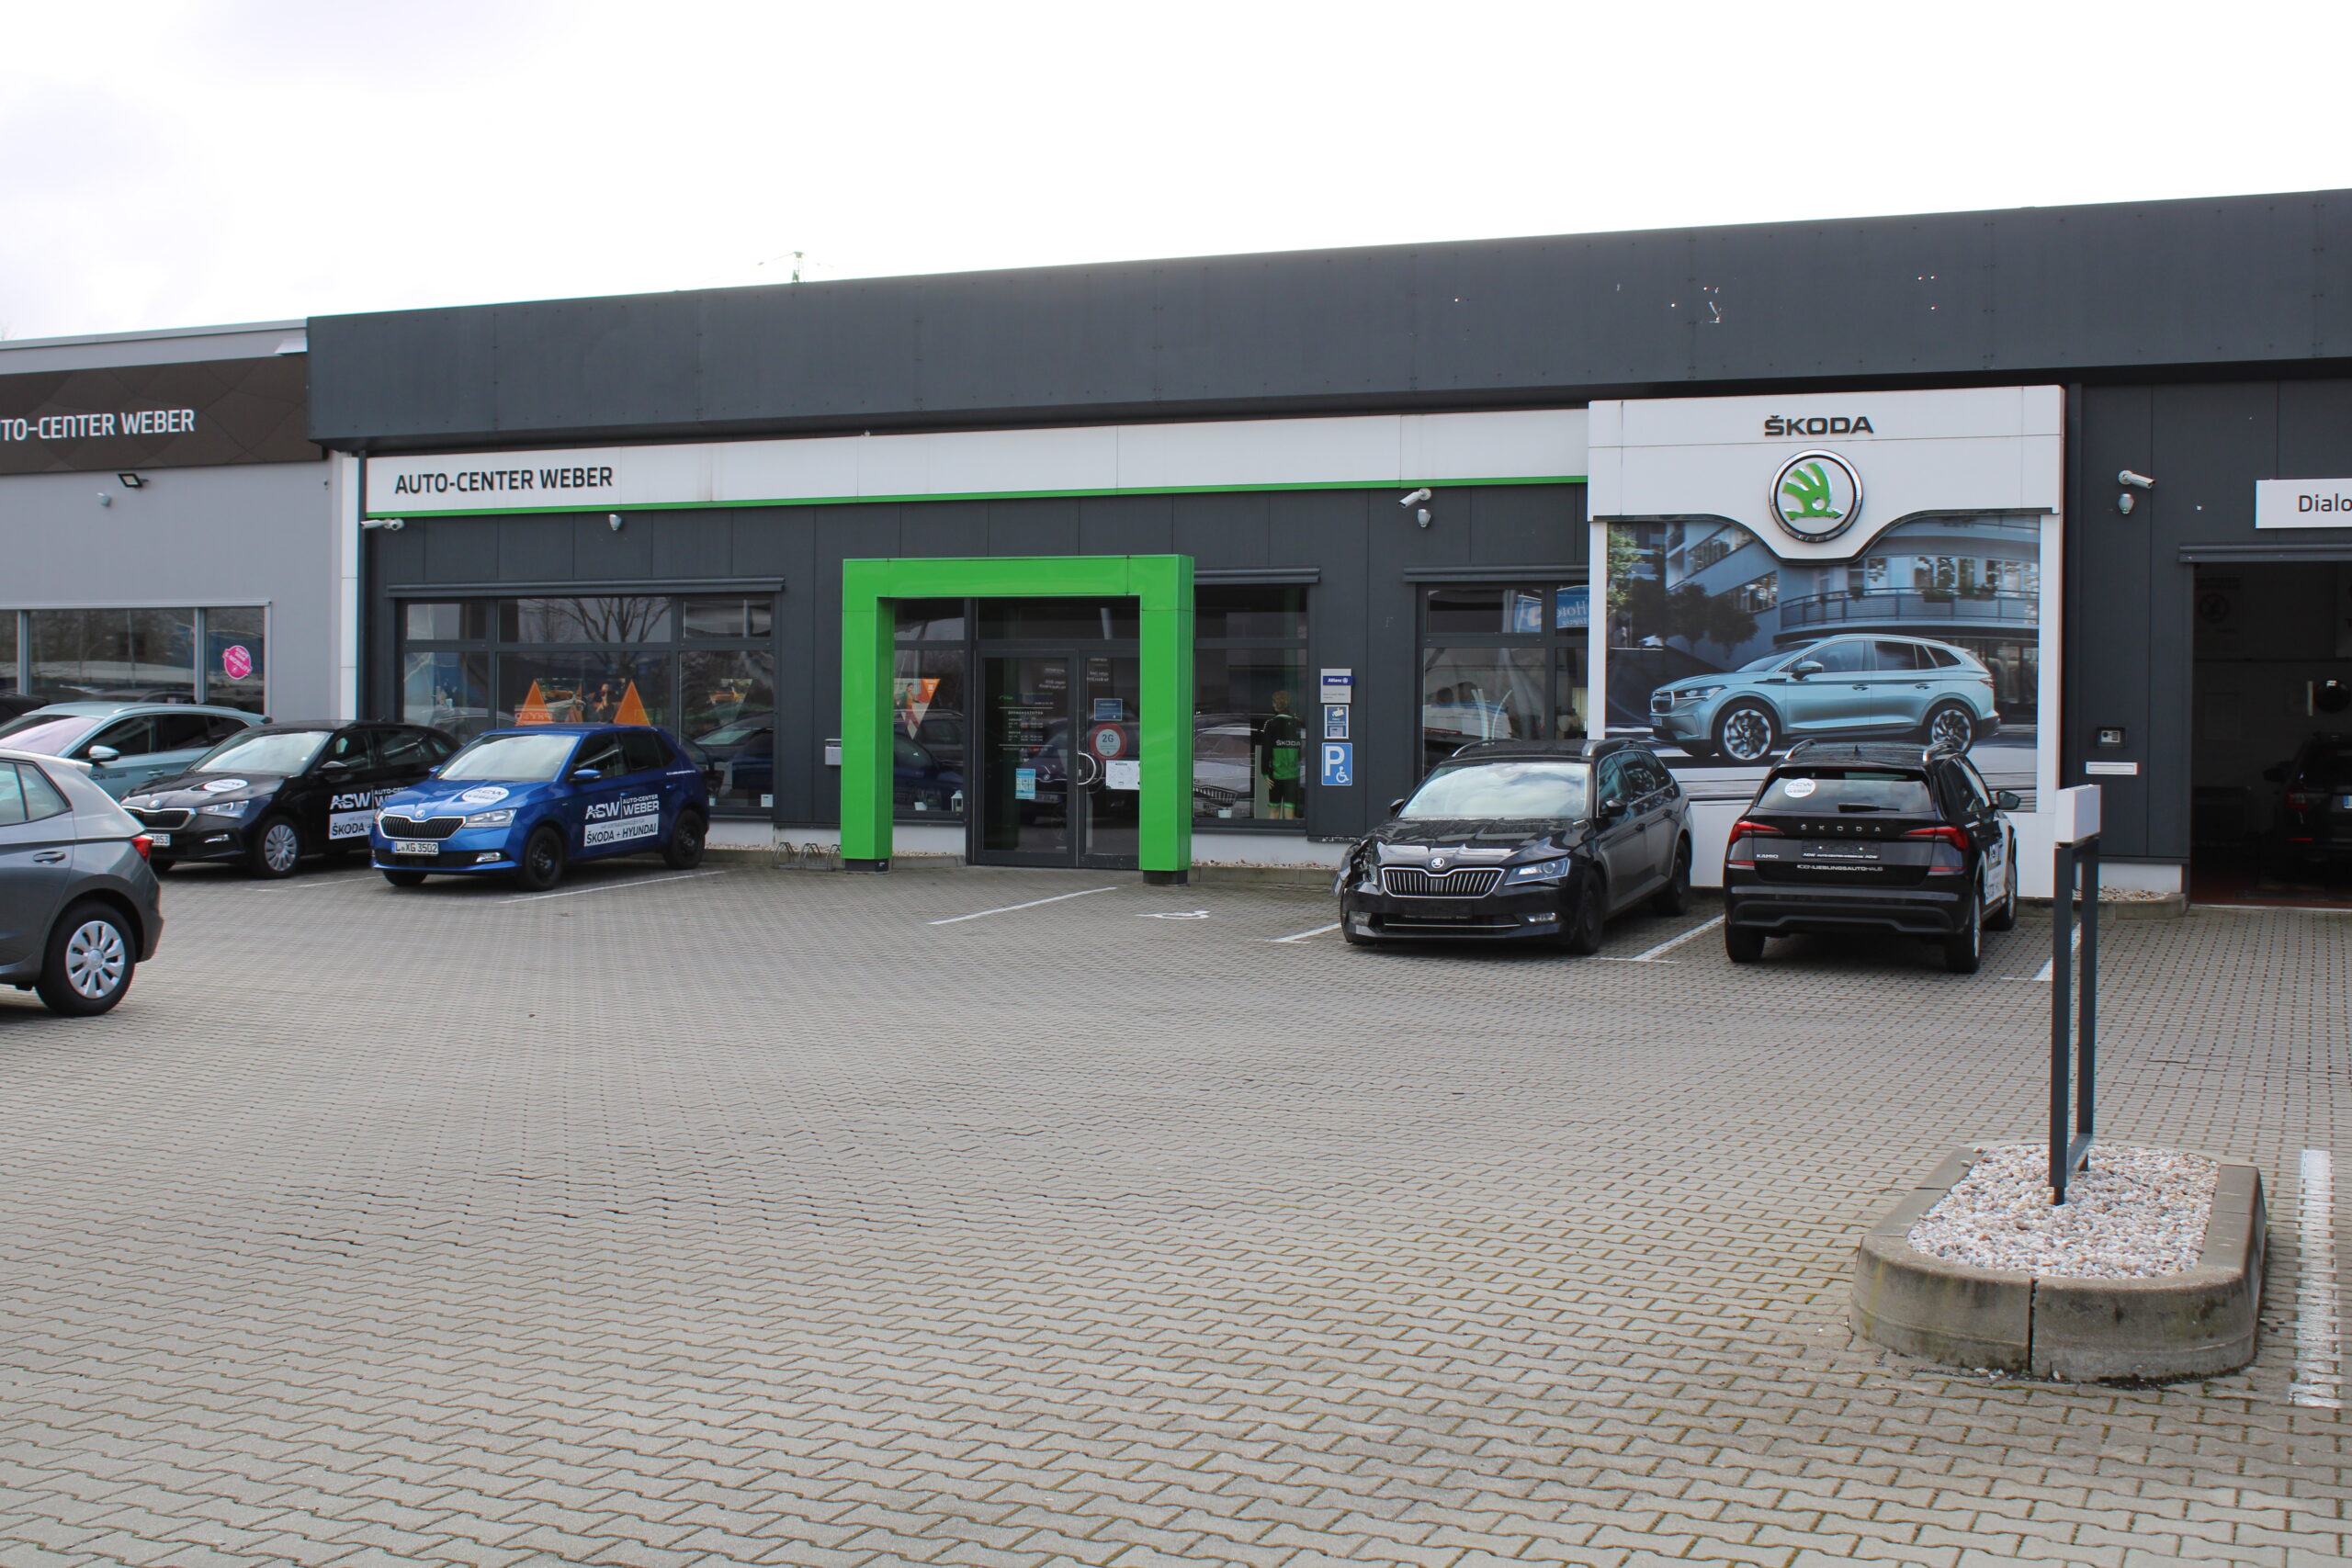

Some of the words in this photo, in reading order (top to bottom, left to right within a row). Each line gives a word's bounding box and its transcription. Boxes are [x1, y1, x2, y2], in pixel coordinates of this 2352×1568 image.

[0, 413, 115, 441] TO-CENTER
[120, 410, 195, 434] WEBER
[1764, 415, 1874, 436] ŠKODA
[395, 469, 534, 494] AUTO-CENTER
[539, 467, 613, 489] WEBER
[1102, 734, 1114, 743] 2G
[1325, 746, 1345, 776] P
[623, 800, 660, 816] WEBER
[332, 822, 366, 836] ŠKODA
[586, 829, 615, 844] ŠKODA
[622, 822, 657, 839] HYUNDAI
[417, 842, 438, 853] 3502
